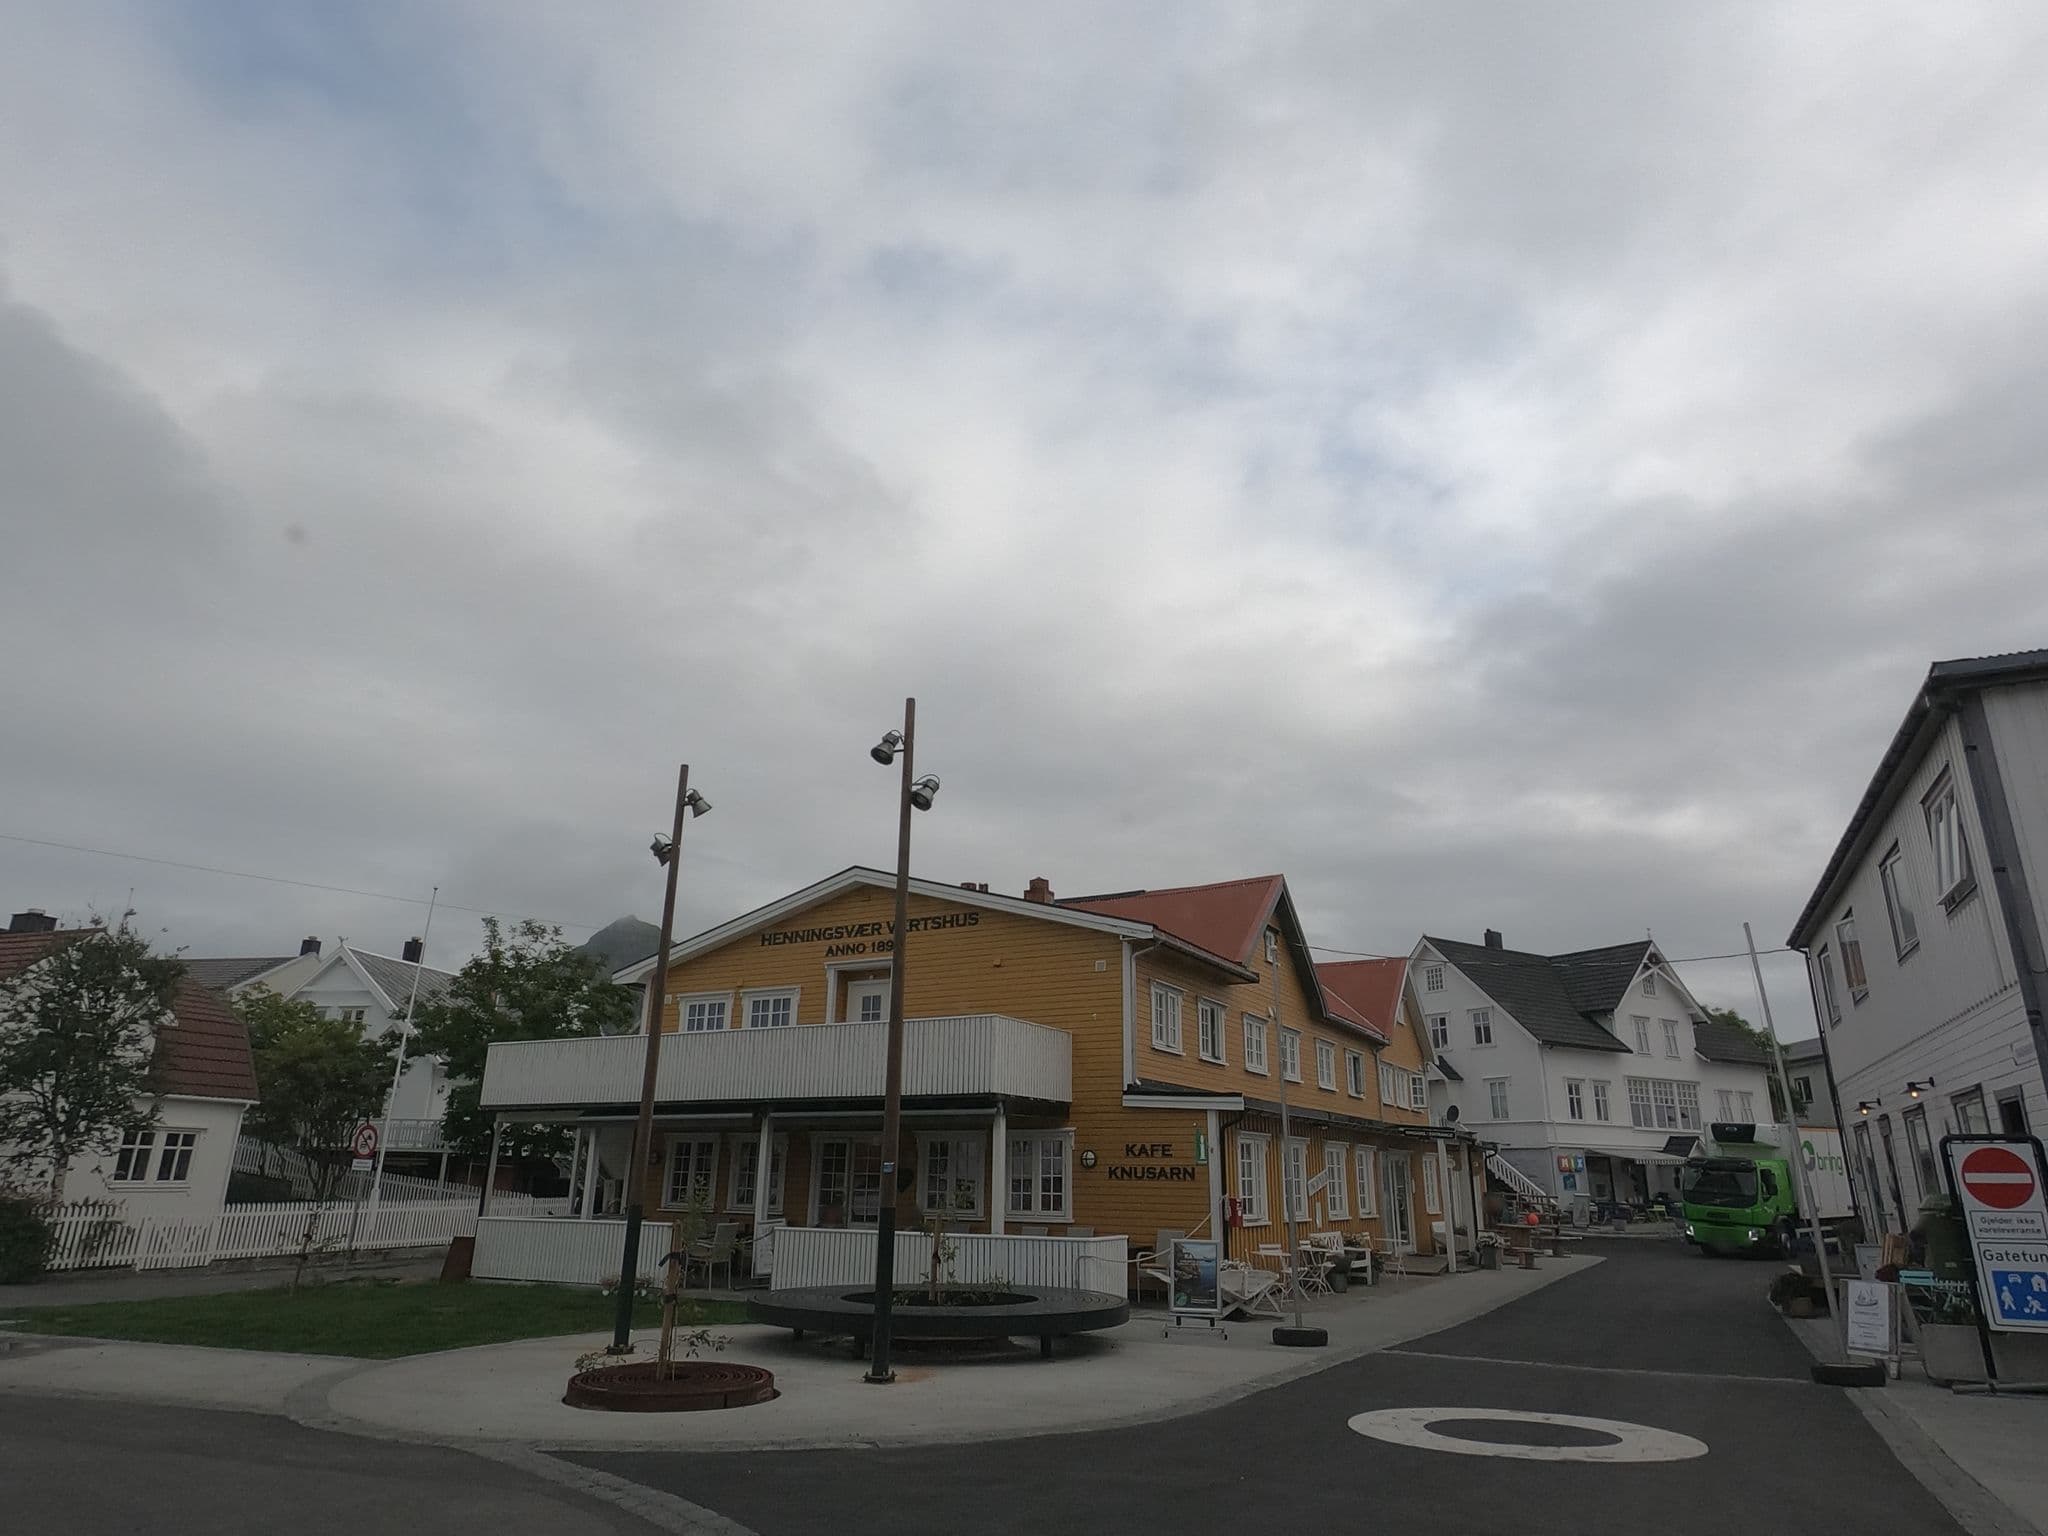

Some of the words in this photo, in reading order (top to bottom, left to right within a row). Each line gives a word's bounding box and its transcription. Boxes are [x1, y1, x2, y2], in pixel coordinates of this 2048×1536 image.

[760, 922, 883, 946] HENNINGSVÆR
[886, 912, 980, 933] VRTSHUS
[825, 943, 866, 957] ANNO
[871, 940, 897, 953] 189
[1125, 1143, 1174, 1158] KAFE
[1817, 1152, 1844, 1176] bring
[1108, 1166, 1196, 1181] KNUSARN
[1980, 1216, 2012, 1225] Gjelder
[2016, 1216, 2036, 1225] ikke
[1983, 1249, 2048, 1263] Gatetun
